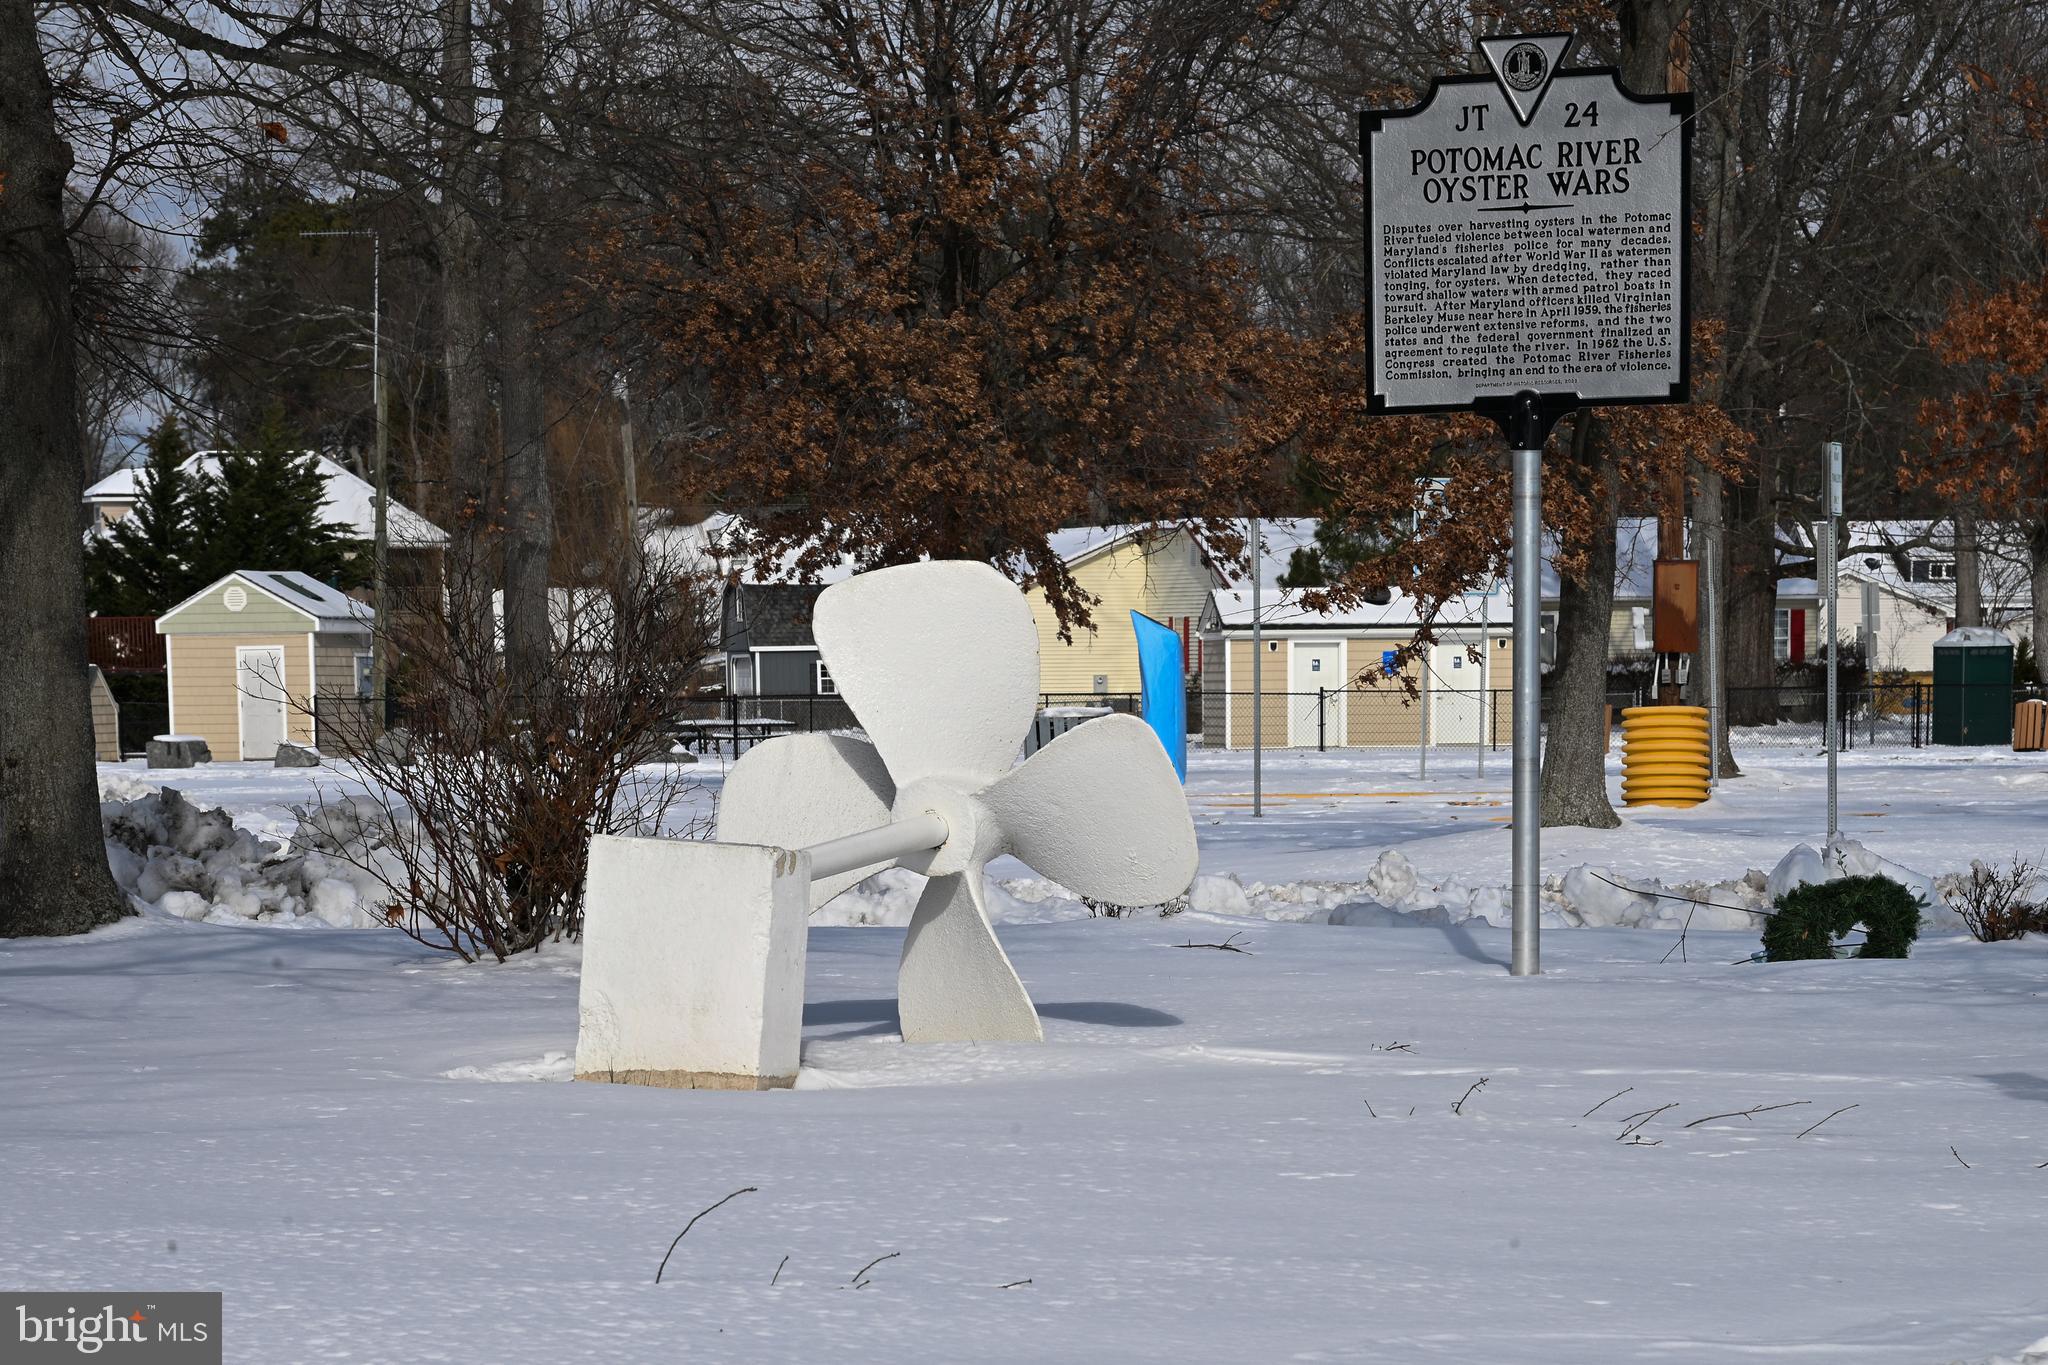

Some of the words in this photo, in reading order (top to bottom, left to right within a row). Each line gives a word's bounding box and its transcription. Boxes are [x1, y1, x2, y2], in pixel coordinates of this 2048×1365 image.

[1455, 104, 1489, 132] JT
[1564, 102, 1598, 128] 24
[1410, 143, 1543, 176] POTOMAC
[1558, 138, 1642, 168] RIVER
[1423, 174, 1529, 203] OYSTER
[1547, 168, 1630, 197] WARS
[1384, 225, 1431, 235] Disputes
[1438, 224, 1463, 232] over
[1470, 219, 1529, 230] harvesting
[1535, 217, 1574, 229] oysters
[1582, 215, 1592, 224] in
[1600, 214, 1617, 223] the
[1625, 212, 1671, 222] Potomac
[1384, 236, 1414, 245] River
[1417, 233, 1451, 243] fueled
[1455, 232, 1500, 241] violence
[1504, 229, 1552, 239] between
[1557, 227, 1583, 237] local
[1588, 225, 1645, 235] watermen
[1649, 223, 1670, 232] and
[1384, 244, 1447, 257] Maryland's
[1455, 243, 1504, 253] fisheries
[1514, 240, 1548, 252] police
[1557, 240, 1573, 248] for
[1581, 239, 1611, 248] many
[1621, 235, 1671, 245] decades.
[1384, 258, 1434, 268] Conflicts
[1438, 254, 1488, 266] escalated
[1492, 253, 1521, 263] after
[1527, 251, 1560, 260] World
[1564, 250, 1586, 259] War
[1590, 249, 1597, 258] II
[1601, 249, 1612, 257] as
[1617, 247, 1671, 256] watermen
[1384, 268, 1427, 279] violated
[1432, 266, 1486, 278] Maryland
[1491, 265, 1509, 274] law
[1514, 264, 1527, 275] by
[1601, 258, 1639, 268] rather
[1644, 257, 1671, 266] than
[1435, 279, 1451, 288] for
[1455, 277, 1500, 289] oysters.
[1507, 275, 1538, 285] When
[1606, 271, 1633, 281] they
[1638, 268, 1671, 278] raced
[1385, 291, 1423, 302] toward
[1427, 290, 1466, 300] shallow
[1472, 288, 1508, 297] waters
[1513, 286, 1537, 295] with
[1543, 284, 1578, 294] armed
[1583, 282, 1618, 293] patrol
[1624, 281, 1655, 290] boats
[1660, 280, 1671, 289] in
[1385, 303, 1426, 315] pursuit.
[1435, 301, 1465, 311] After
[1470, 298, 1525, 310] Maryland
[1530, 296, 1574, 306] officers
[1577, 294, 1609, 304] killed
[1615, 293, 1671, 304] Virginian
[1385, 314, 1433, 324] Berkeley
[1438, 312, 1465, 322] Muse
[1469, 311, 1494, 320] near
[1498, 309, 1523, 319] here
[1527, 308, 1536, 317] in
[1541, 306, 1570, 318] April
[1605, 304, 1622, 313] the
[1625, 302, 1671, 312] fisheries
[1385, 325, 1418, 337] police
[1421, 323, 1480, 334] underwent
[1484, 321, 1536, 331] extensive
[1598, 316, 1619, 326] and
[1625, 315, 1644, 324] the
[1650, 315, 1671, 323] two
[1385, 336, 1417, 346] states
[1423, 335, 1443, 344] and
[1451, 334, 1470, 343] the
[1478, 332, 1519, 342] federal
[1528, 329, 1593, 342] government
[1601, 327, 1652, 337] finalized
[1658, 327, 1671, 335] an
[1385, 346, 1442, 359] agreement
[1447, 346, 1458, 354] to
[1462, 343, 1508, 356] regulate
[1513, 342, 1531, 351] the
[1536, 341, 1569, 351] river.
[1577, 340, 1587, 349] In
[1593, 338, 1619, 349] 1962
[1624, 338, 1642, 347] the
[1647, 336, 1671, 346] U.S.
[1386, 359, 1434, 371] Congress
[1443, 356, 1487, 367] created
[1496, 354, 1515, 364] the
[1524, 352, 1571, 363] Potomac
[1579, 351, 1610, 361] River
[1618, 349, 1671, 359] Fisheries
[1458, 365, 1505, 378] bringing
[1510, 367, 1522, 375] an
[1526, 365, 1545, 375] end
[1549, 364, 1559, 373] to
[1563, 363, 1581, 373] the
[1584, 363, 1602, 372] era
[1606, 362, 1616, 371] of
[1621, 362, 1671, 371] violence.
